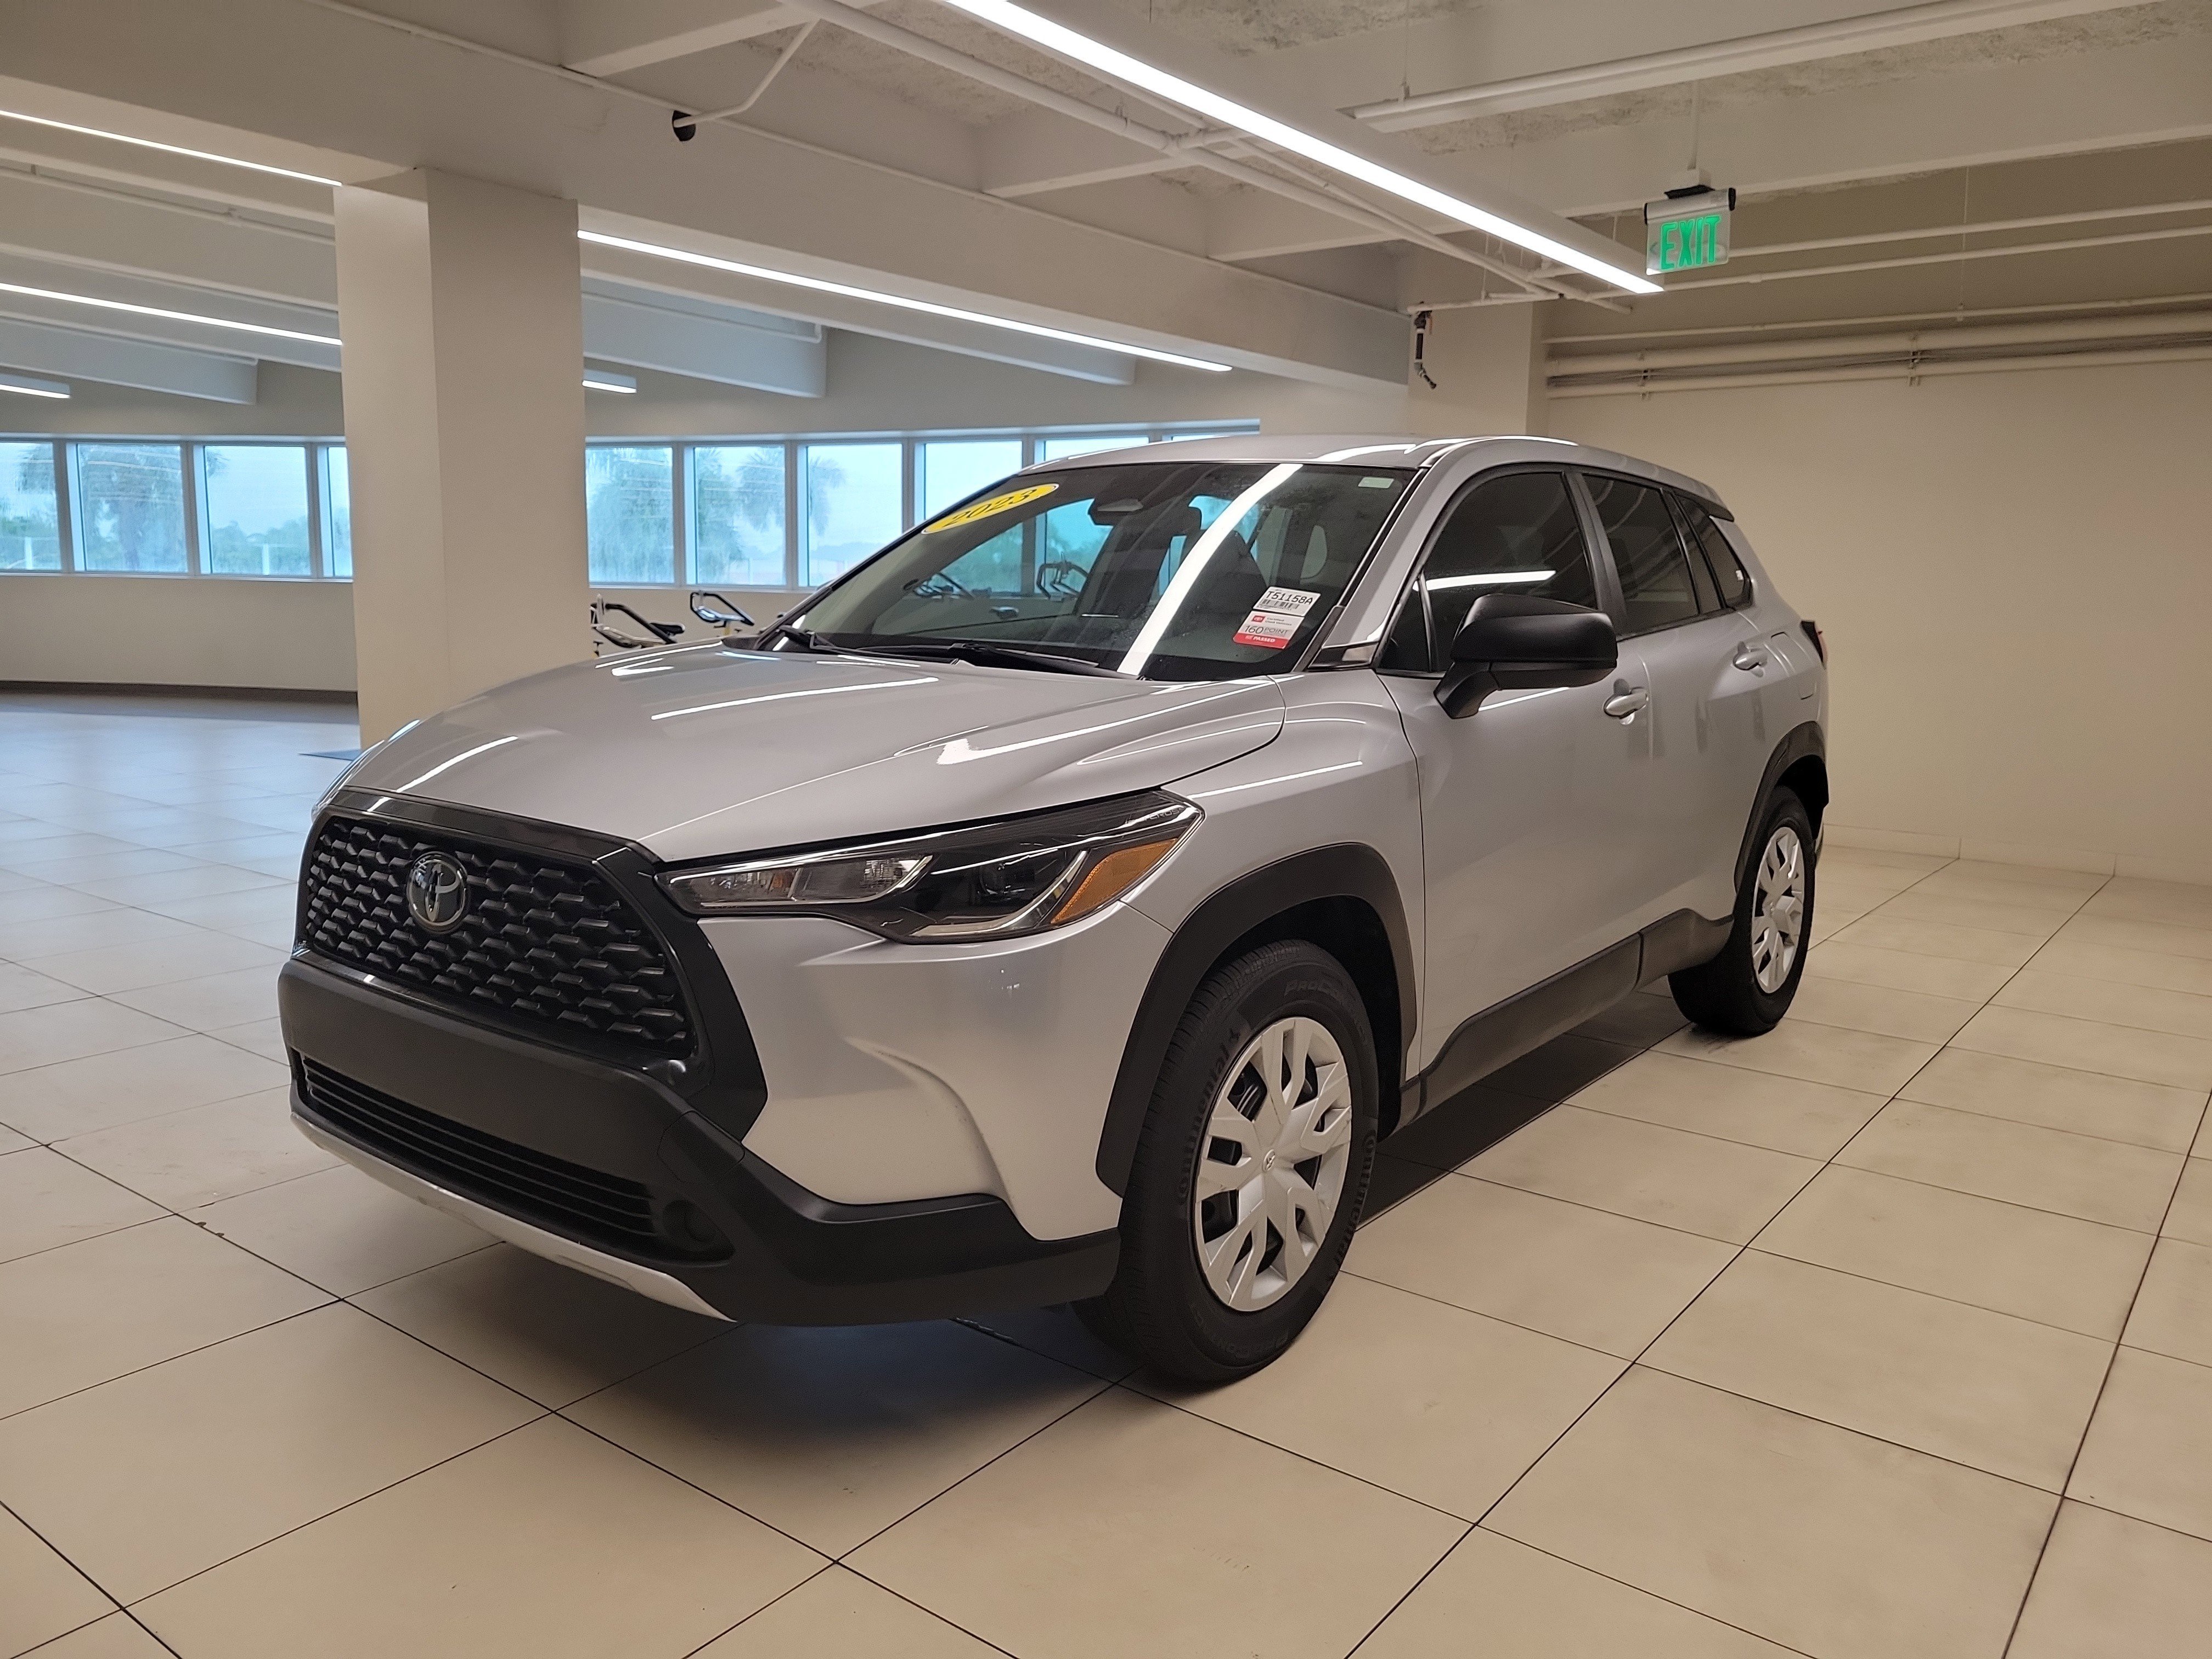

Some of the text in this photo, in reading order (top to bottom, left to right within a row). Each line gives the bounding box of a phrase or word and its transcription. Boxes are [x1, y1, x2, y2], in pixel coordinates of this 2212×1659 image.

[1660, 215, 1720, 270] EXIT
[942, 489, 1037, 528] 2023
[1265, 591, 1313, 605] T51158A
[1245, 625, 1263, 634] 160
[1263, 627, 1289, 635] POINT
